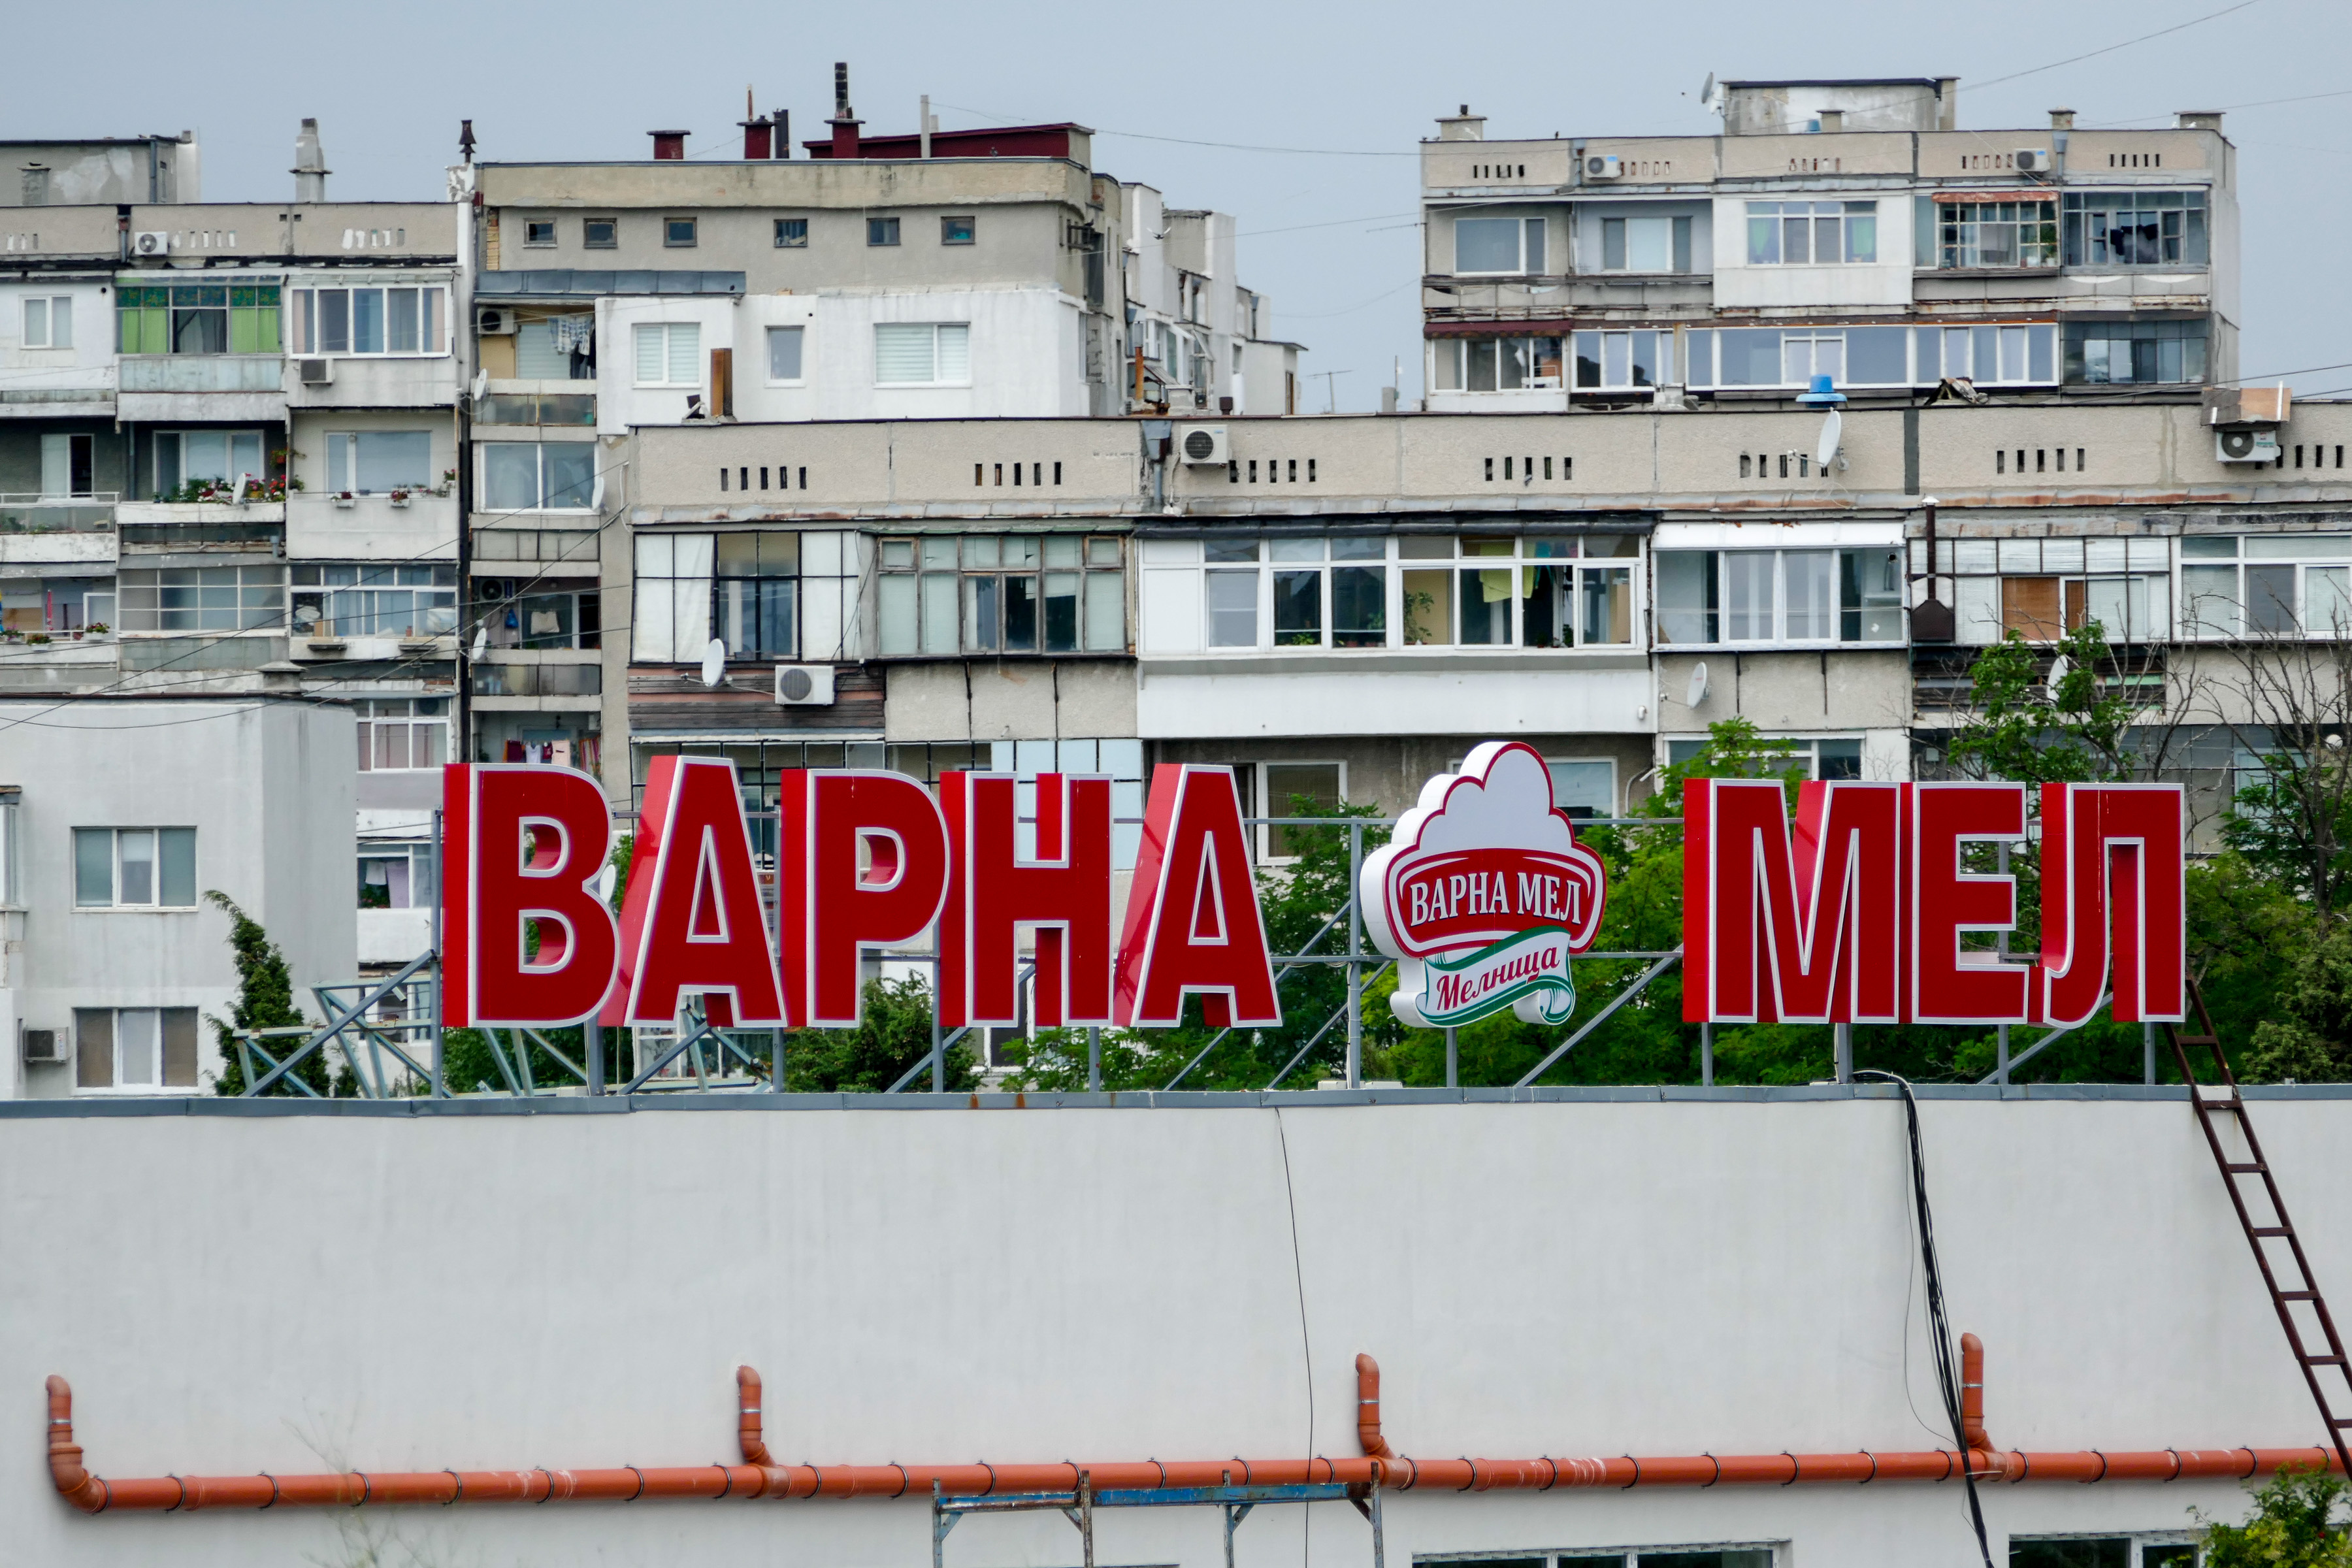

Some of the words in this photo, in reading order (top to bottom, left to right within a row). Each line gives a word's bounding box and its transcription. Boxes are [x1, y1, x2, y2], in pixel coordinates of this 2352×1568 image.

[442, 755, 1283, 1028] ВАРНА
[1683, 778, 2185, 1030] МЕЛ
[1410, 872, 1511, 926] ВАРНА
[1517, 872, 1581, 924] МЕЛ
[1437, 947, 1560, 1011] Мелница
